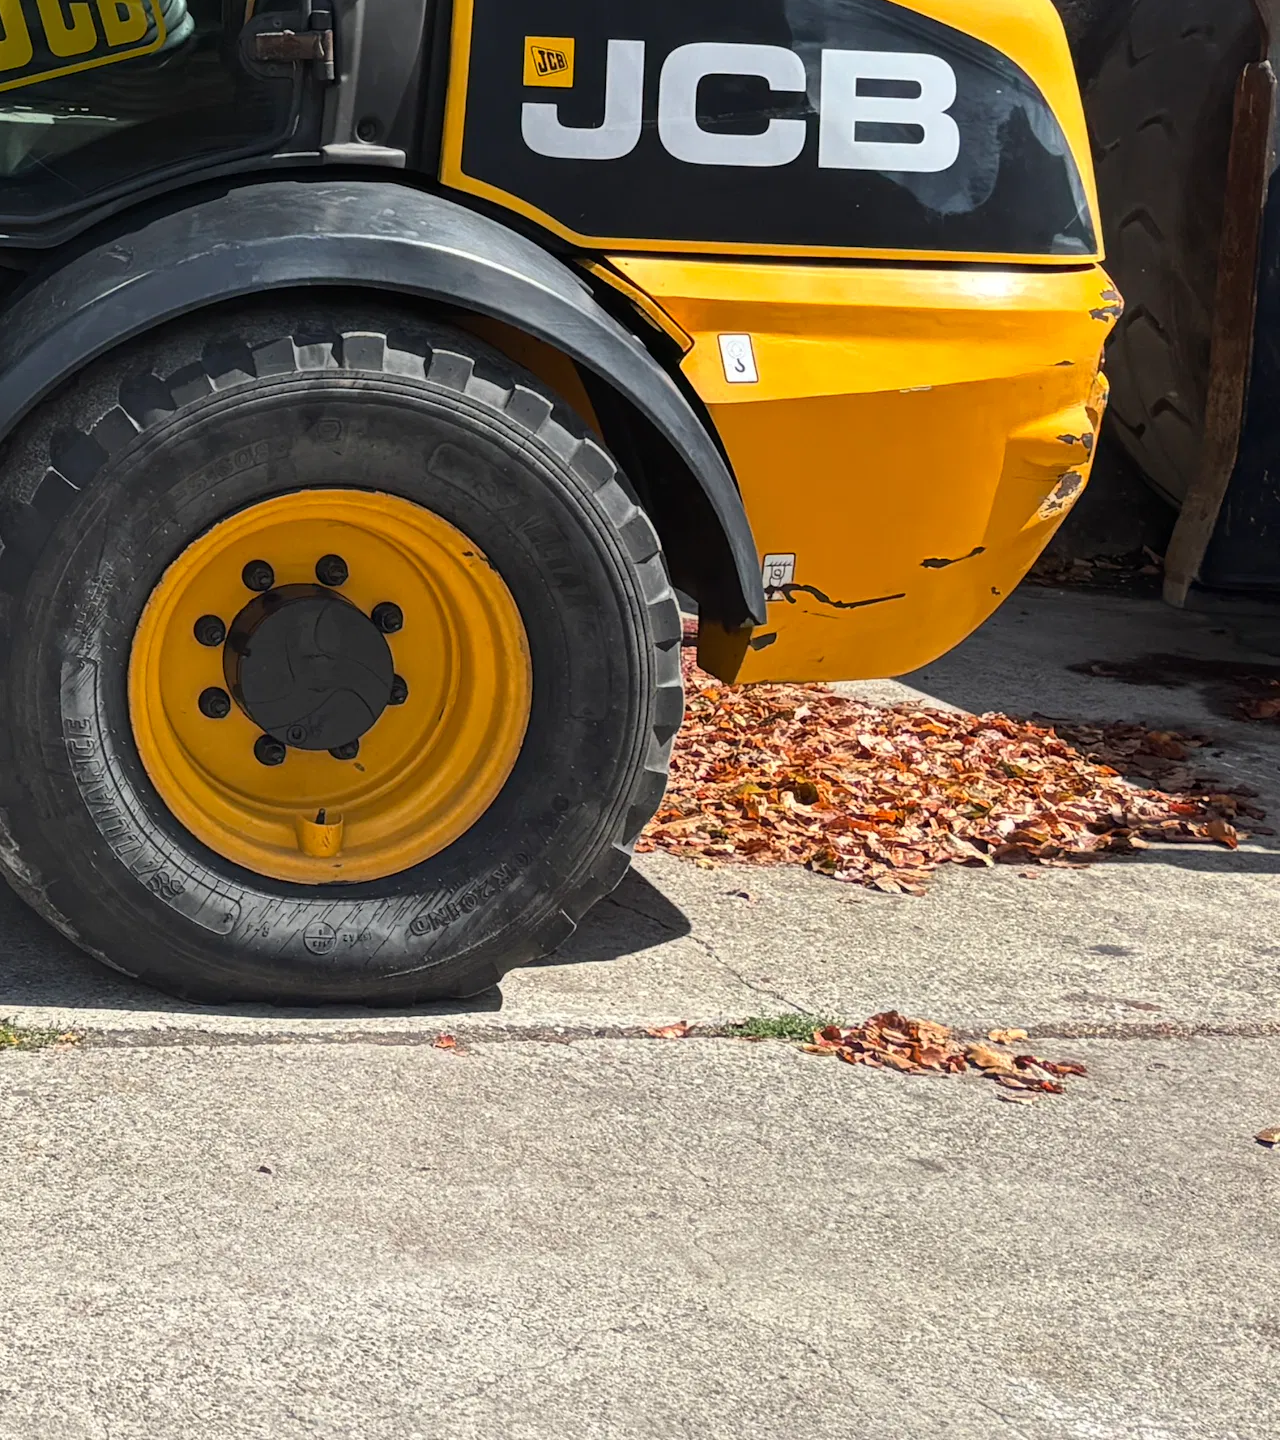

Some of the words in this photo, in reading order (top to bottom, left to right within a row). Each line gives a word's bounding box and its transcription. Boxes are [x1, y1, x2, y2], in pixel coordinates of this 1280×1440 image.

[521, 40, 960, 173] JCB
[538, 49, 565, 73] JCB
[64, 717, 167, 877] ALLIANCE
